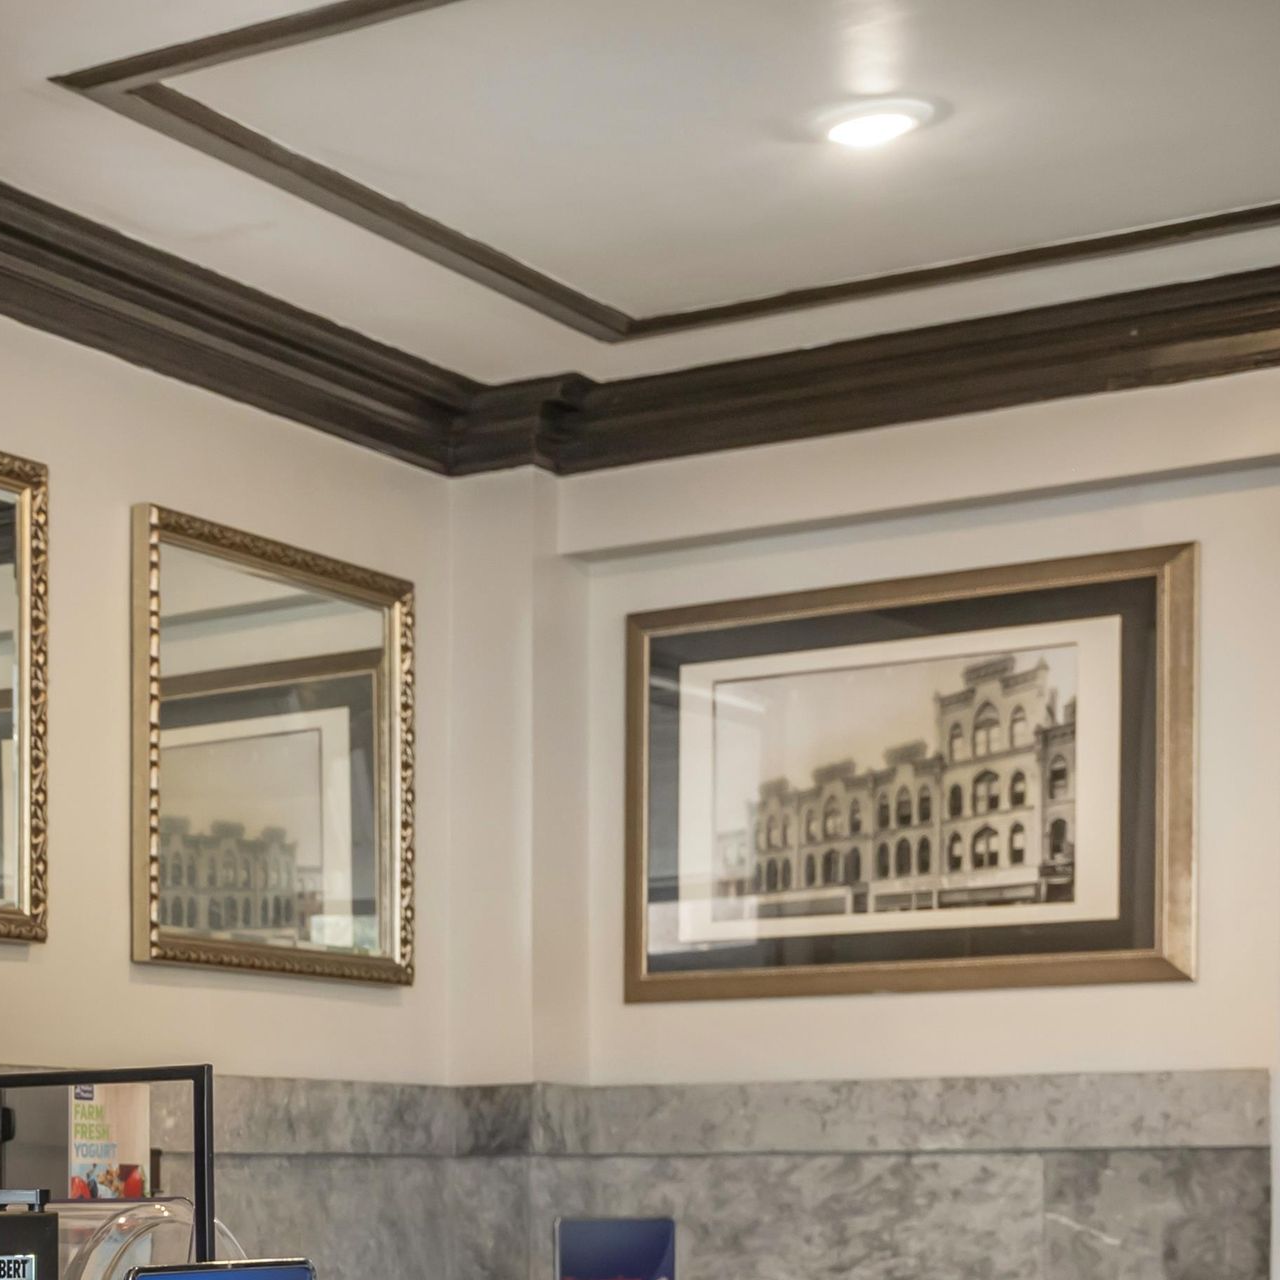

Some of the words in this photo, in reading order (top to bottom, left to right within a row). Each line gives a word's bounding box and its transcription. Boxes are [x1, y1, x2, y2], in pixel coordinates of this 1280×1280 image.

[73, 1103, 105, 1120] FARM
[73, 1123, 110, 1140] FRESH
[73, 1143, 118, 1158] YOGURT
